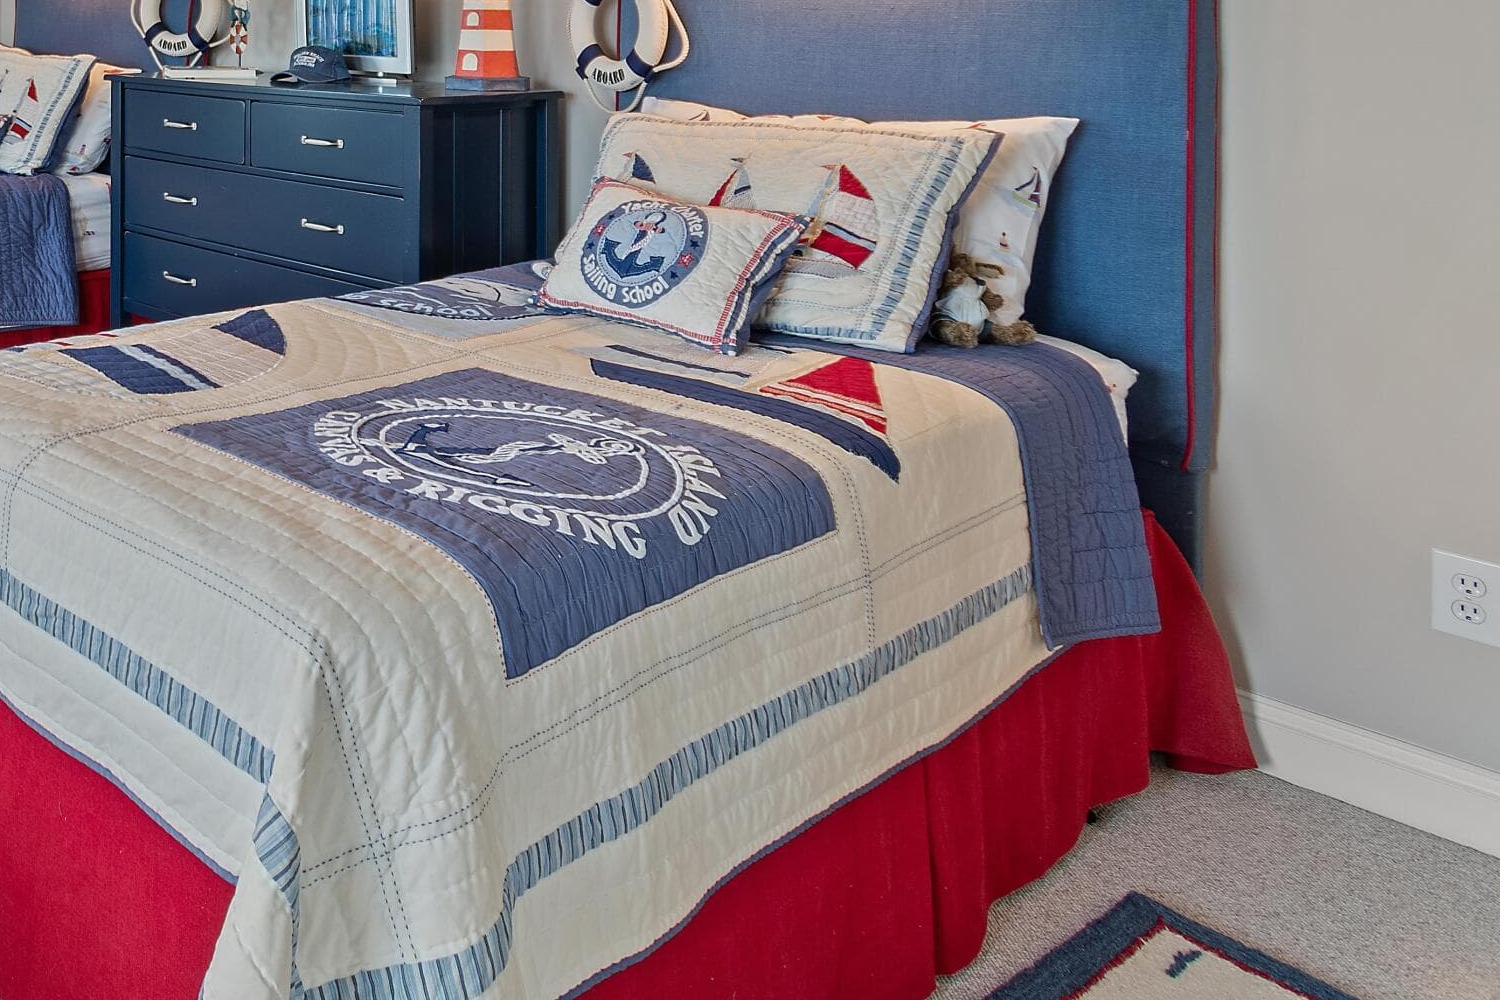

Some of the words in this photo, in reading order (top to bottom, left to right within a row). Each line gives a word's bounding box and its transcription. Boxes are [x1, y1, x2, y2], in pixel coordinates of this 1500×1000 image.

[158, 39, 187, 51] ABOARD
[591, 67, 625, 86] ABOARD
[670, 205, 705, 239] Charter
[582, 253, 617, 300] Sailing
[313, 410, 376, 467] CANVAS
[362, 467, 404, 484] &
[404, 478, 647, 560] RIGGING
[376, 397, 667, 437] NANTUCKET
[666, 444, 728, 546] ISLAND
